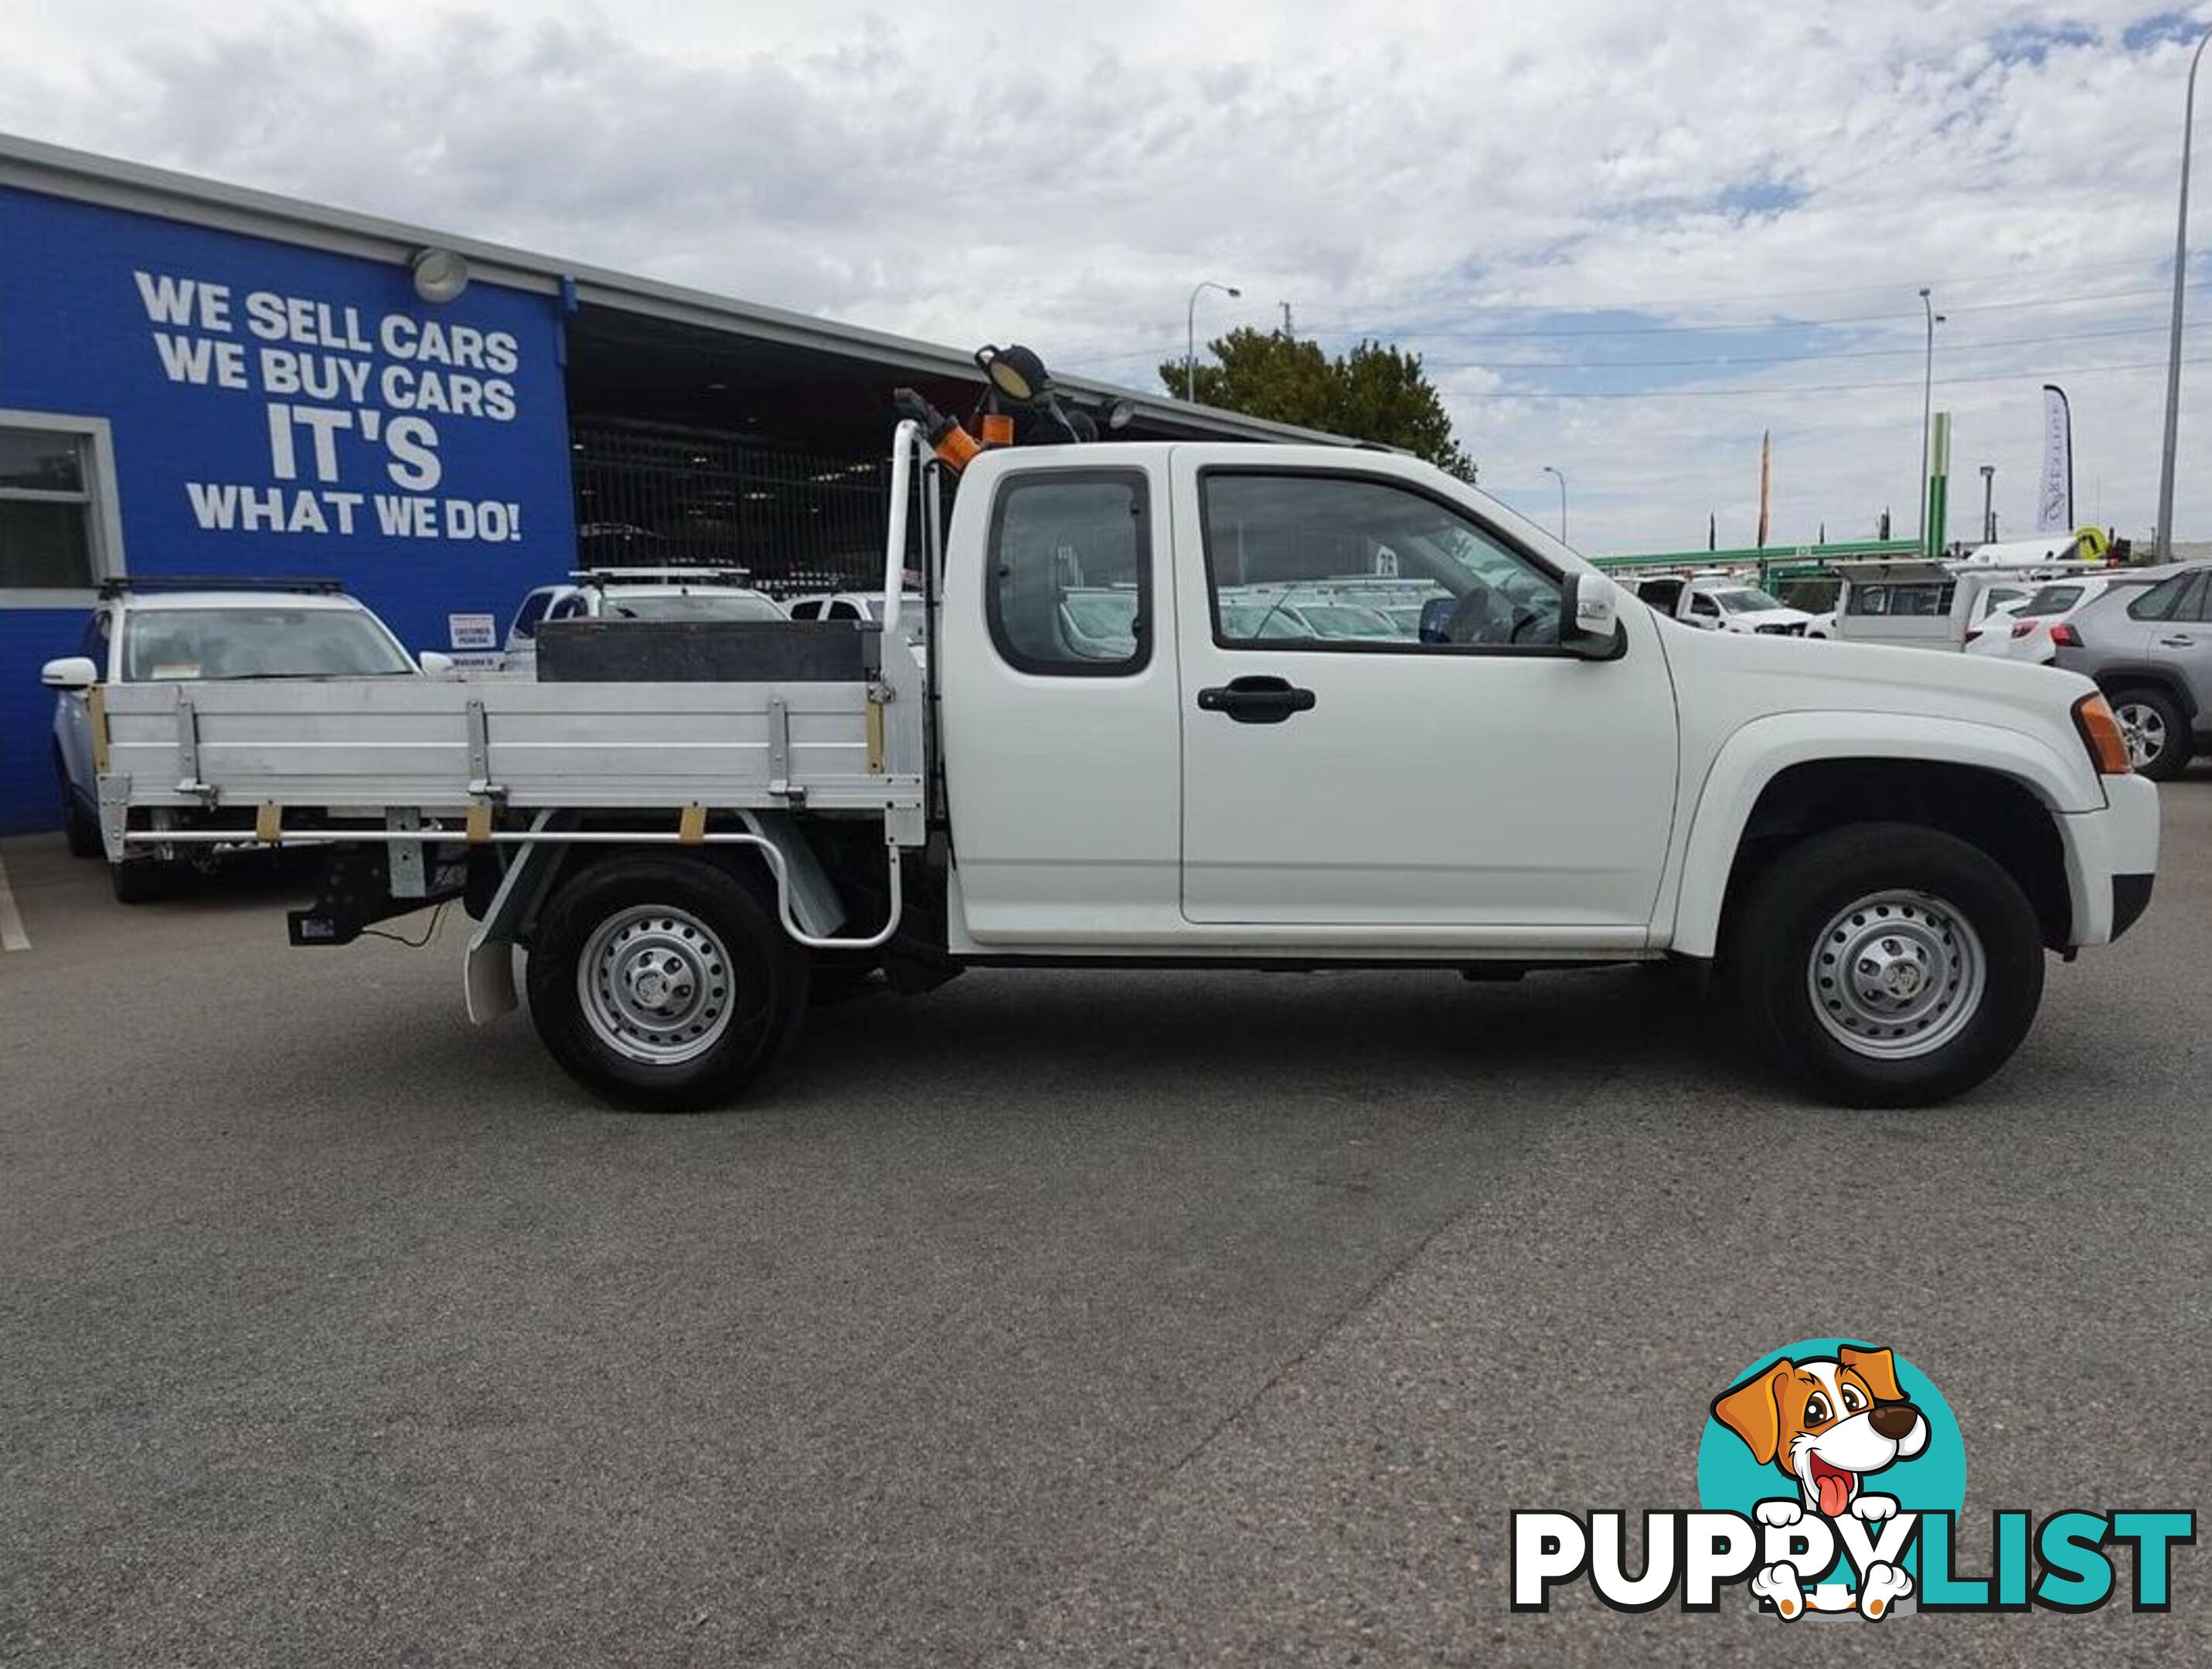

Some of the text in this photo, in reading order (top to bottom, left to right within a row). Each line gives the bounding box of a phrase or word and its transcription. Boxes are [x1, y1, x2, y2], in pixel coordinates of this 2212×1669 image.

[134, 270, 519, 374] WE SELL CARS
[153, 332, 516, 421] WE BUY CARS
[267, 402, 441, 491] IT'S
[185, 482, 521, 542] WHAT WE DO!
